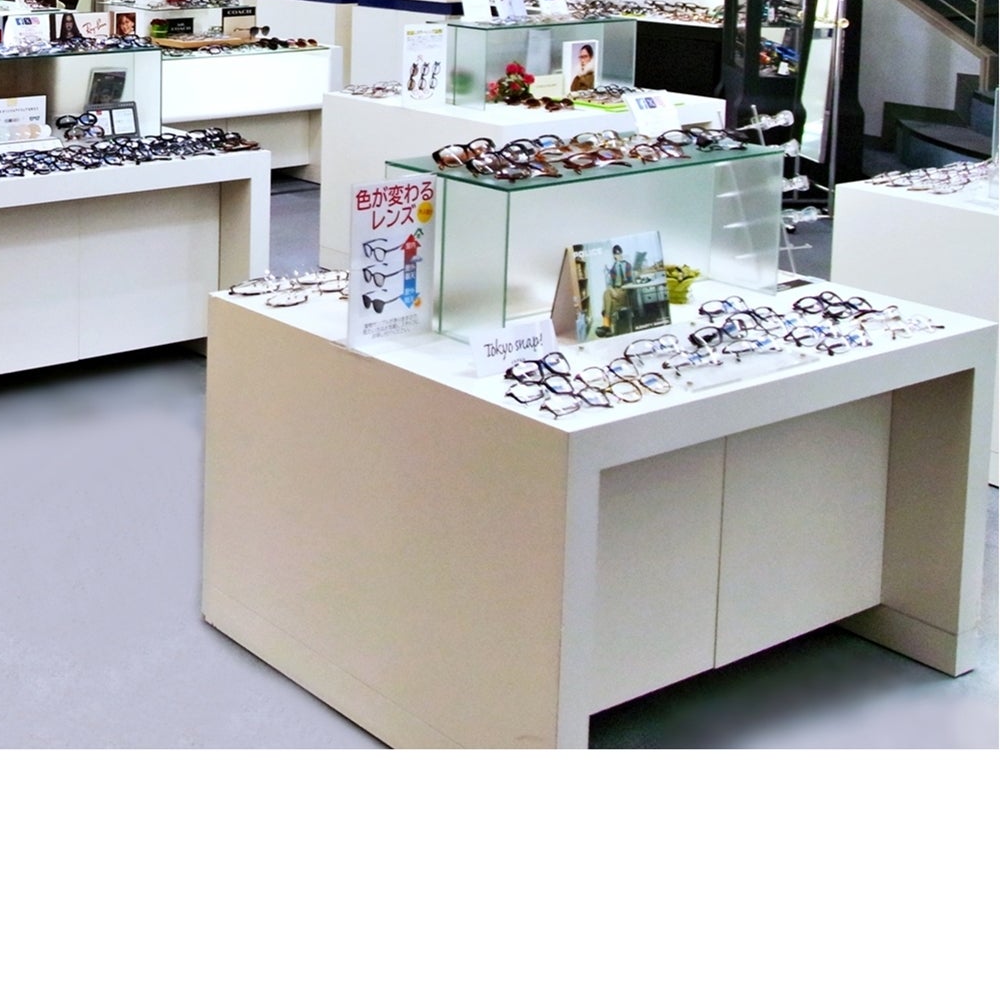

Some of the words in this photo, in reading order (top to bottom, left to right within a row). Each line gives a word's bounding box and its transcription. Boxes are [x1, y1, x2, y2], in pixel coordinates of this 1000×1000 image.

[356, 181, 434, 211] 色が変わる
[372, 204, 417, 230] レンズ
[483, 336, 513, 360] Tokyo
[514, 333, 544, 356] snap!
